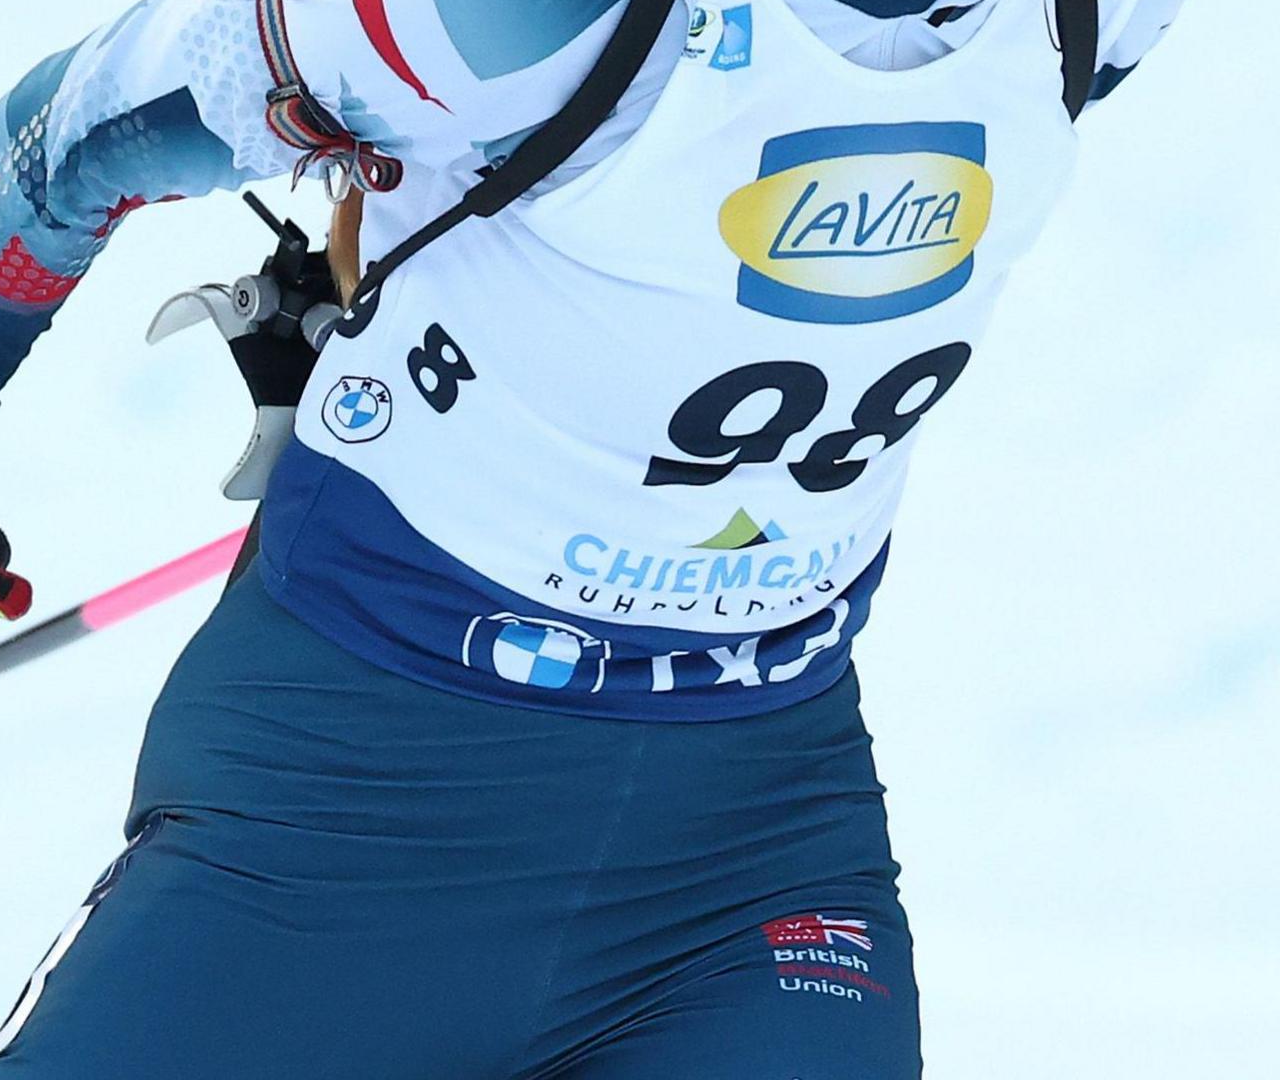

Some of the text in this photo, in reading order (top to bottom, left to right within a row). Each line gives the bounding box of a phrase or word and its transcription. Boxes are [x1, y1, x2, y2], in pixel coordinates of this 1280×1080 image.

[641, 340, 973, 493] 98
[773, 947, 870, 973] British
[778, 977, 863, 1003] Union
